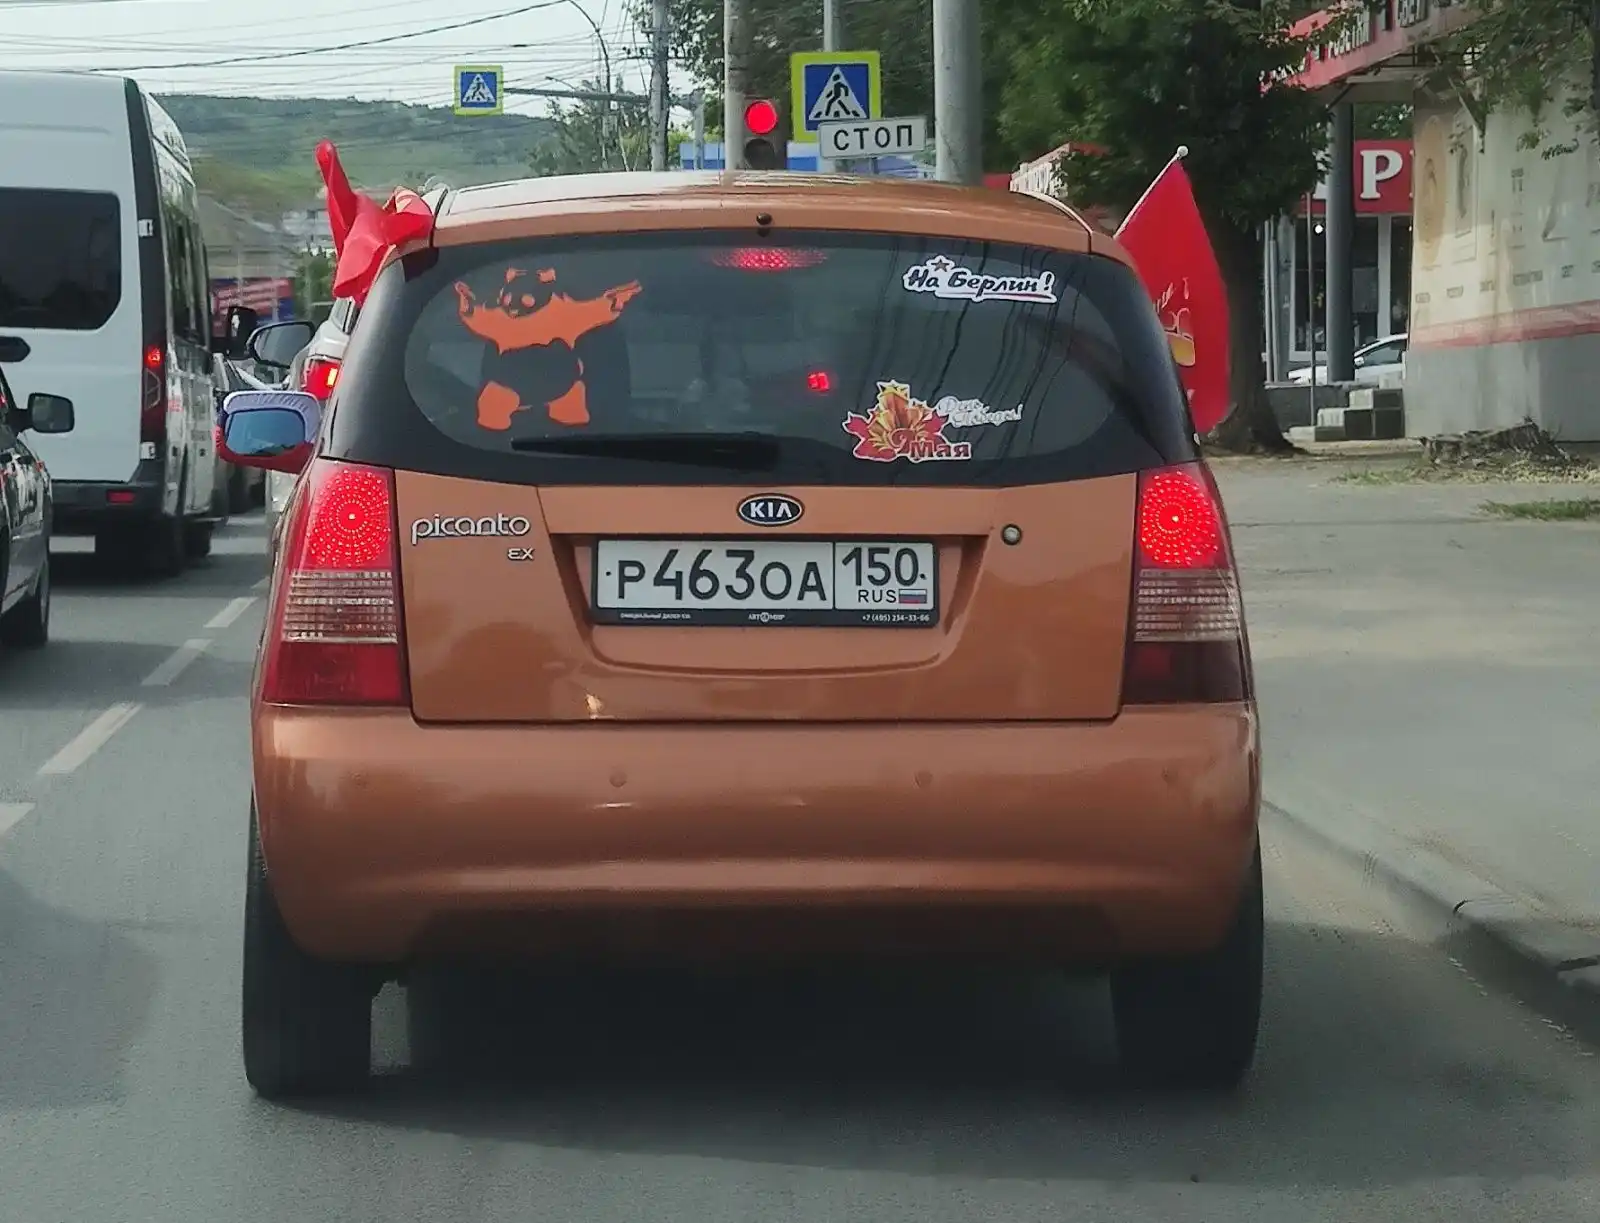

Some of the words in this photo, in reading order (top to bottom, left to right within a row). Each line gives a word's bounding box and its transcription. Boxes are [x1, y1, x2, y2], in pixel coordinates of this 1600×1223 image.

[833, 124, 913, 151] СТОП
[908, 268, 939, 289] На
[947, 271, 1053, 298] Берлин!
[749, 502, 793, 519] KIA
[410, 512, 531, 546] picanto
[507, 547, 535, 561] EX
[841, 546, 920, 587] 150
[857, 589, 897, 604] RUS
